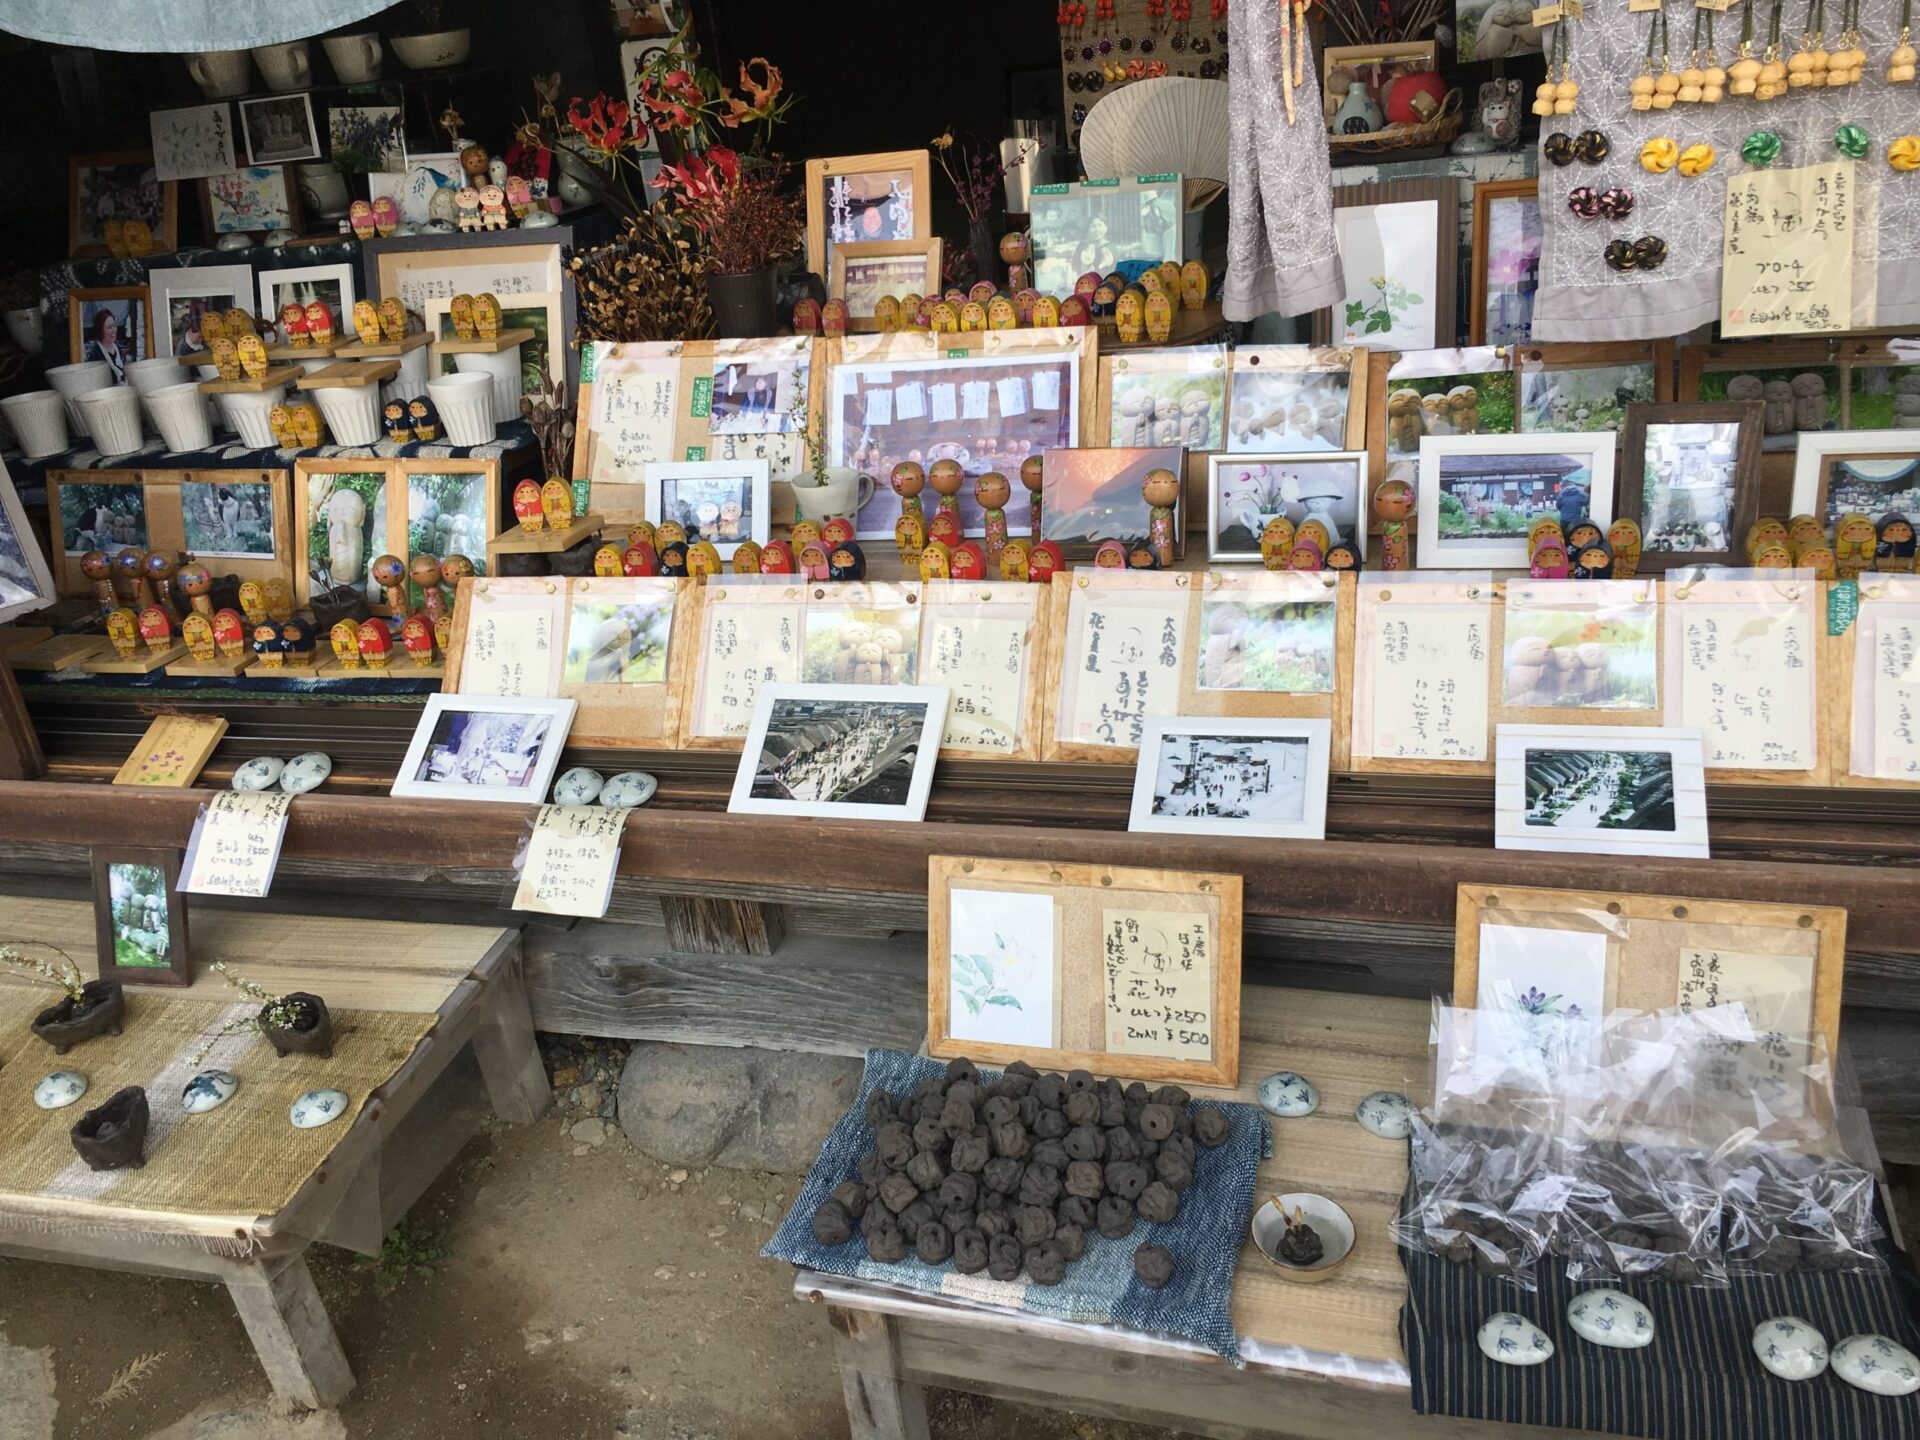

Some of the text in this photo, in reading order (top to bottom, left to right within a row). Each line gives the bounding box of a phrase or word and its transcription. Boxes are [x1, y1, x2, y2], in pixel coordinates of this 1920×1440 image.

[1755, 259, 1805, 279] ブローチ
[1165, 1027, 1210, 1045] ¥500
